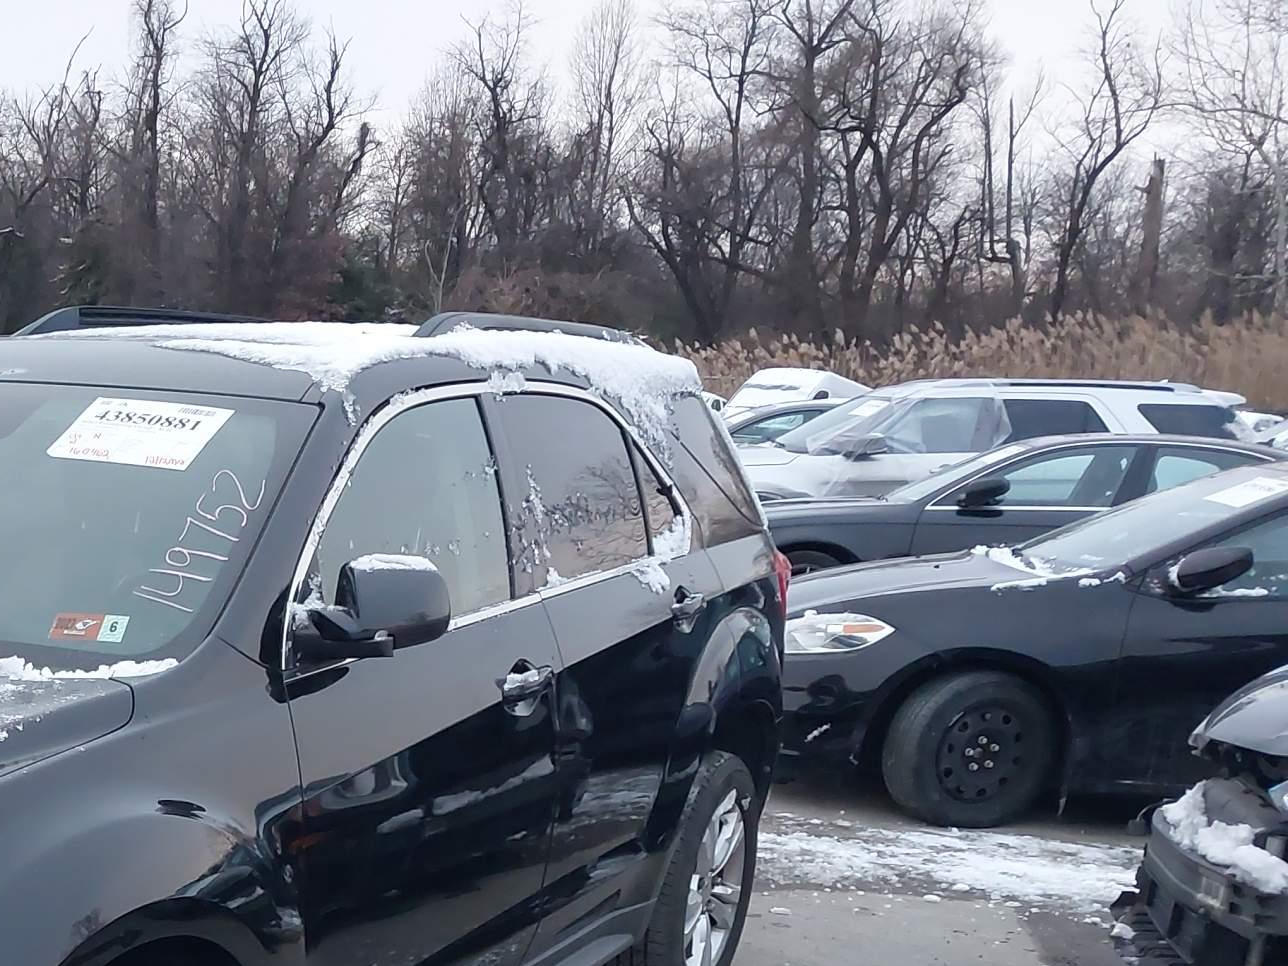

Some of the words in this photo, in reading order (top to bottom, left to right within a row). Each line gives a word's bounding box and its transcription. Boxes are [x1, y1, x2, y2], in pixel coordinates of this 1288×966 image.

[94, 409, 202, 431] 43850881
[132, 469, 266, 613] 149752
[109, 621, 119, 633] 6
